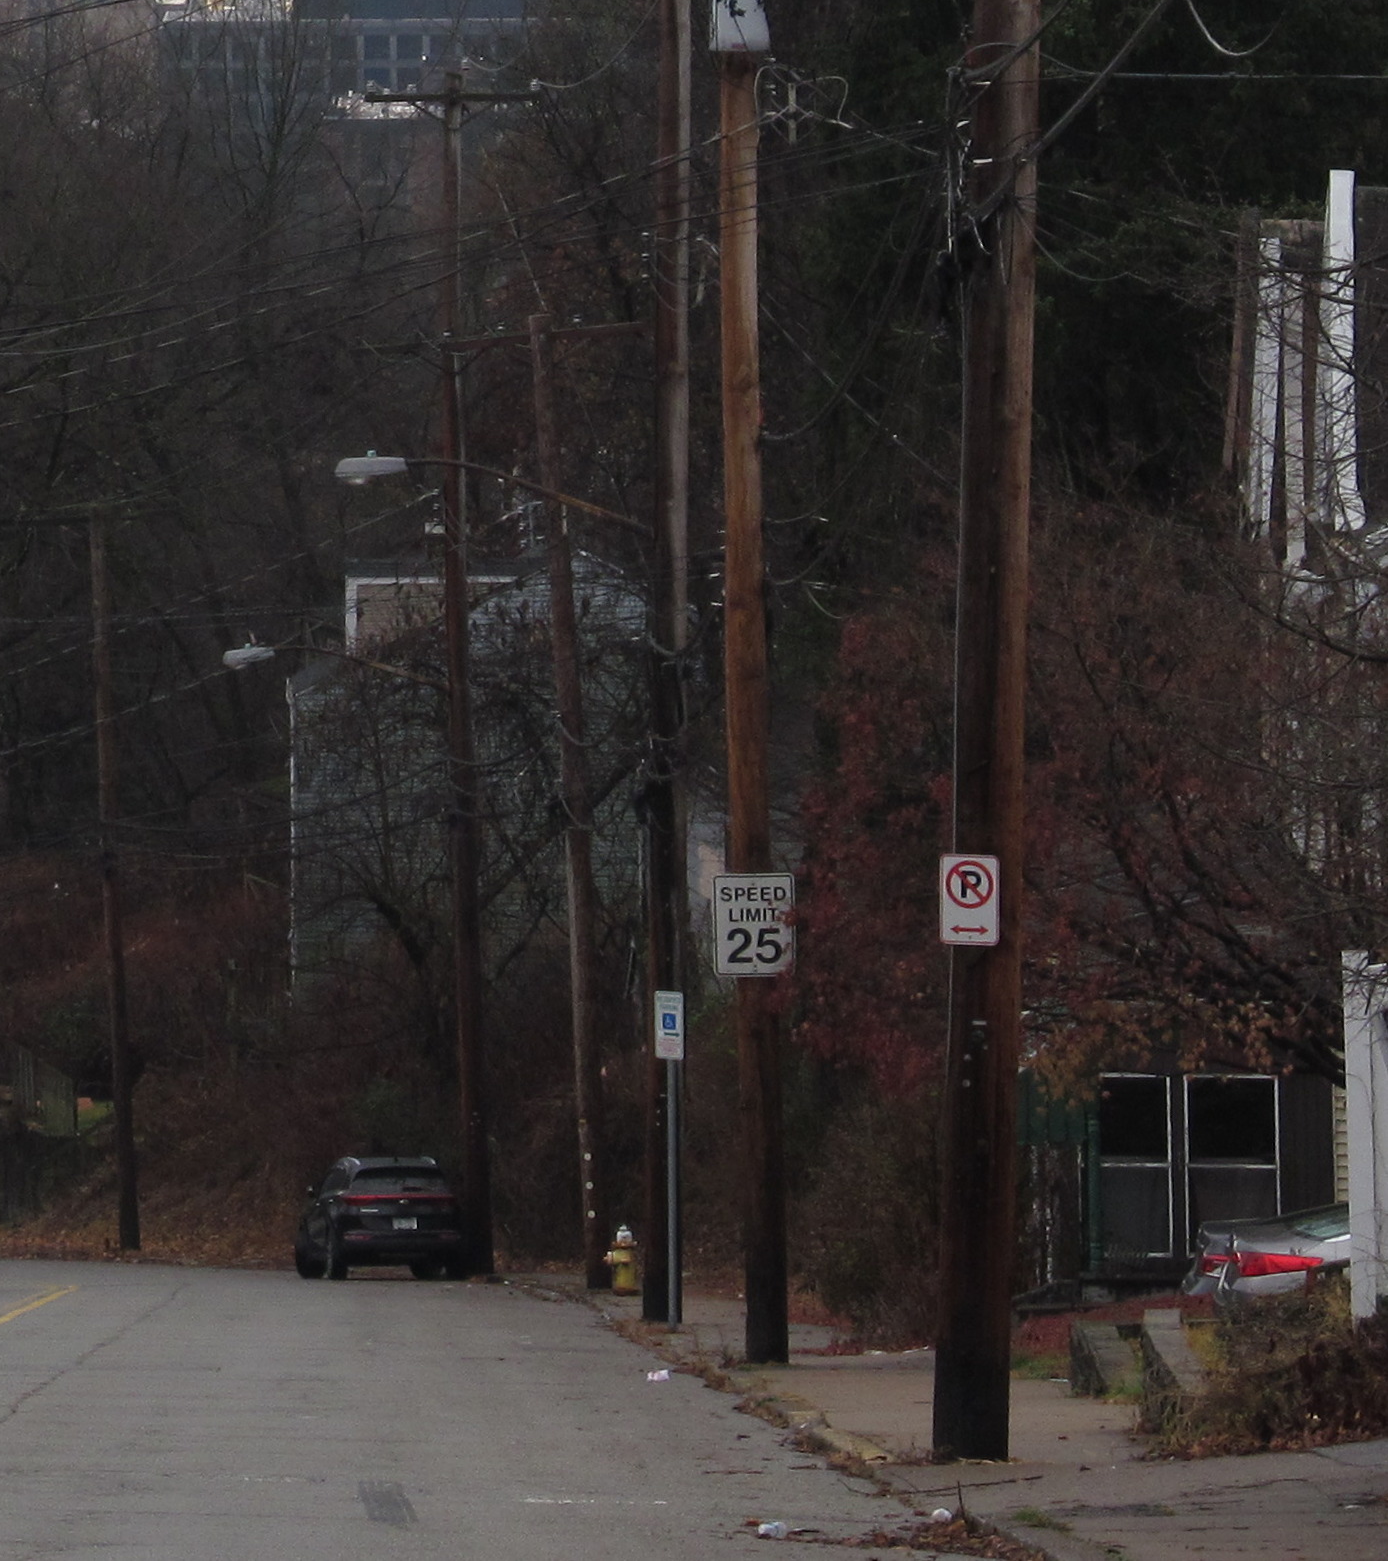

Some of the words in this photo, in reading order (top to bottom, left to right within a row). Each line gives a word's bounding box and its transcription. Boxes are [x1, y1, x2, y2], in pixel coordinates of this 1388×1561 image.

[720, 886, 786, 902] SPEED
[729, 908, 778, 923] LIMIT
[727, 928, 782, 964] 25
